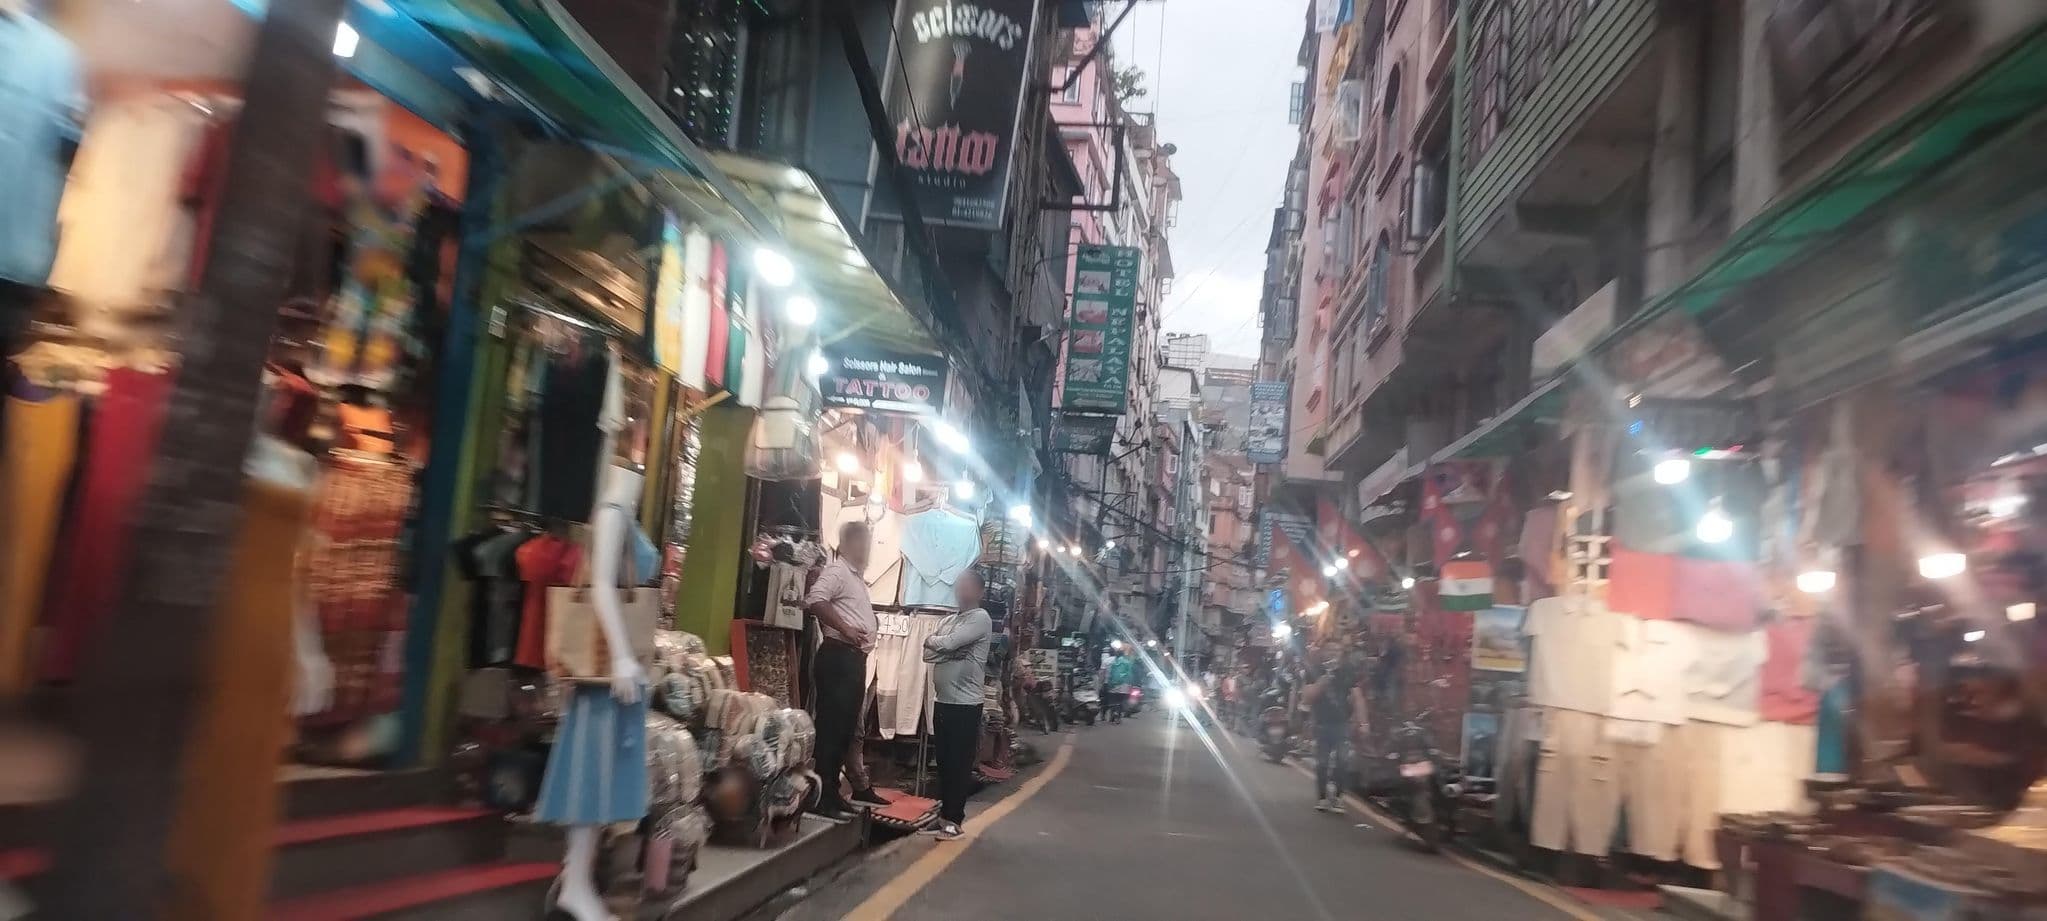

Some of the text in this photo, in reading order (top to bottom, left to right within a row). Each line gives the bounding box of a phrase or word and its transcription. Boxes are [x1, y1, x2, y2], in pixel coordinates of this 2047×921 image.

[1113, 248, 1134, 297] HOTEL
[1104, 307, 1127, 385] NEPALAYA
[842, 356, 879, 373] Scissors
[879, 359, 898, 374] Hair
[898, 361, 922, 376] Salon
[832, 376, 930, 401] TATTOO
